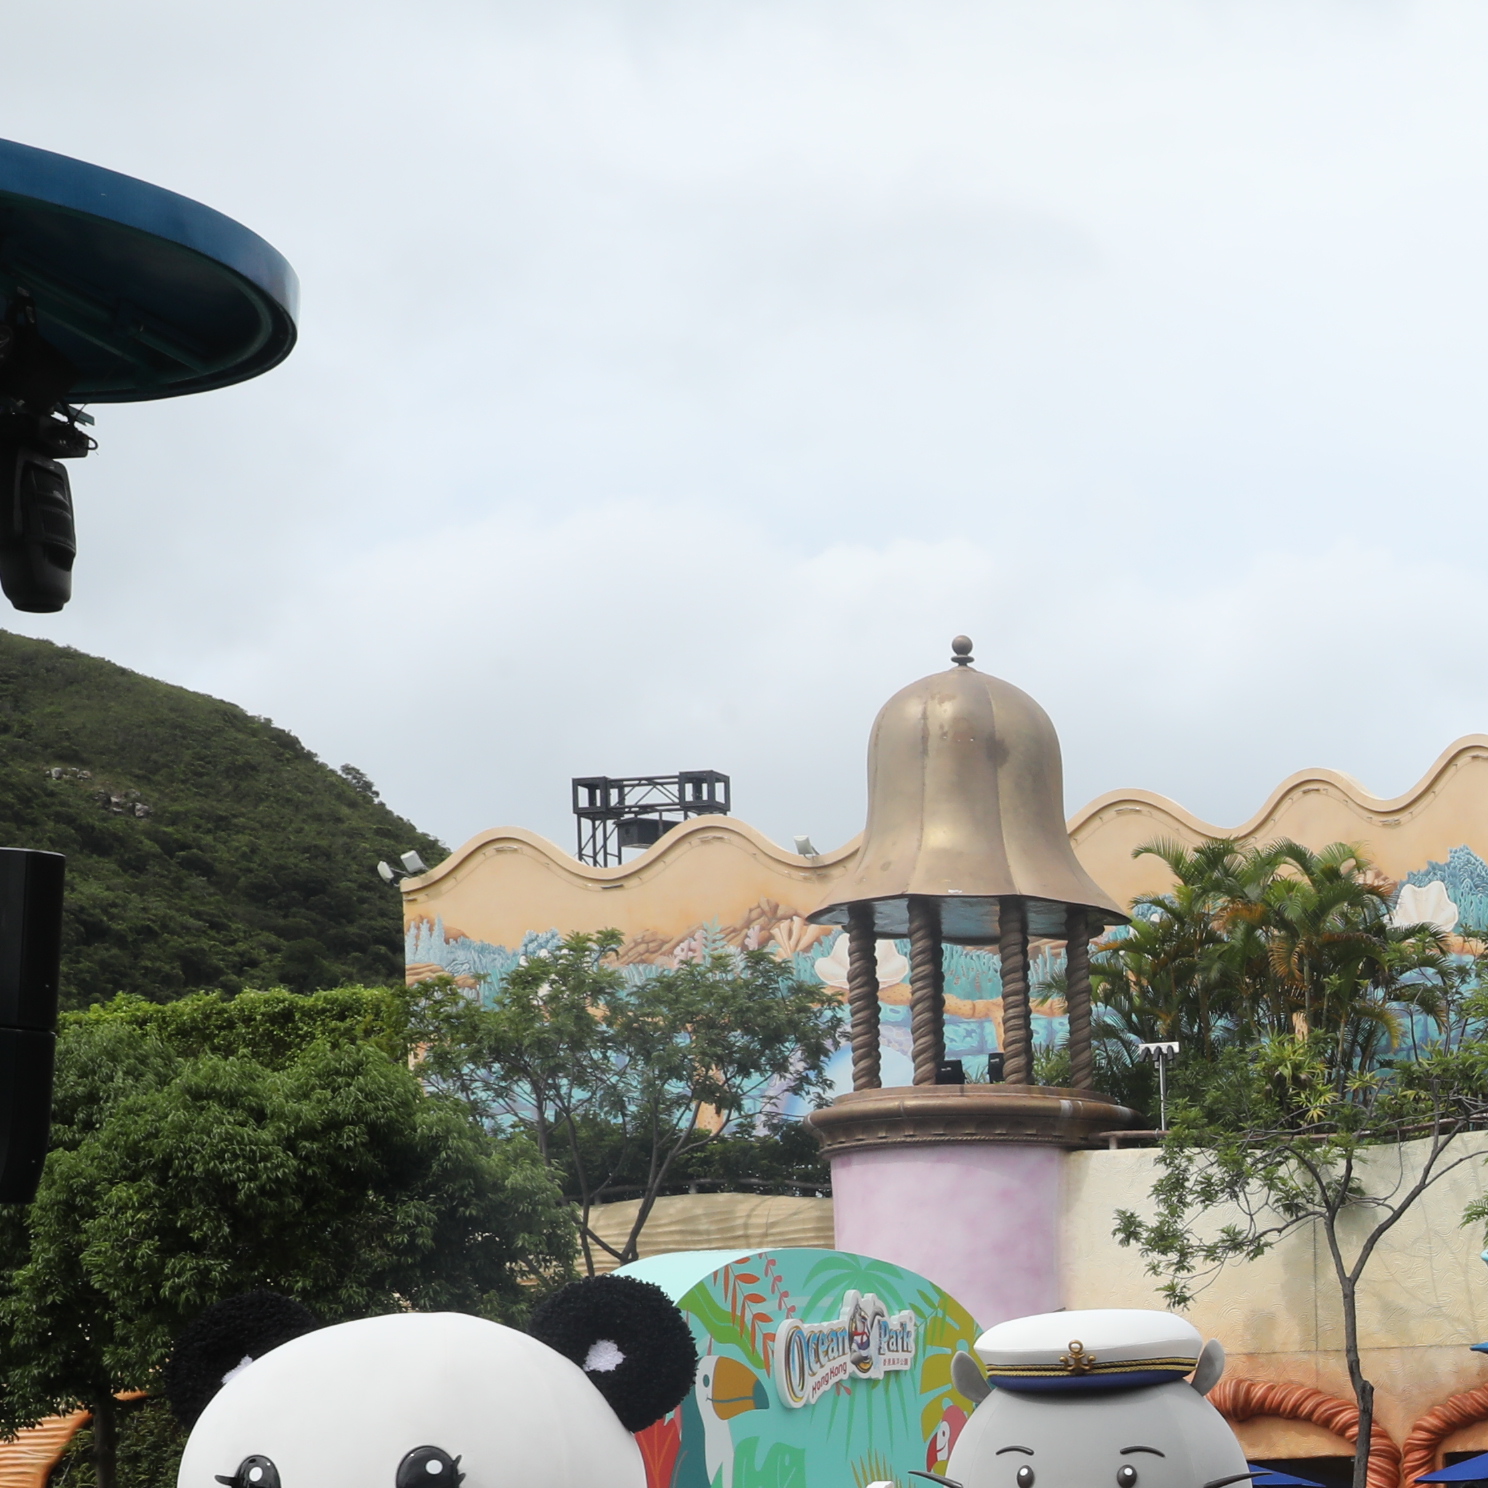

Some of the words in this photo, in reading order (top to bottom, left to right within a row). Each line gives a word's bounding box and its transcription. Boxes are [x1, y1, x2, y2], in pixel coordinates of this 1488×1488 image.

[785, 1325, 849, 1403] Ocean
[877, 1319, 913, 1355] Park
[811, 1373, 829, 1398] Hong
[829, 1361, 847, 1379] Kong
